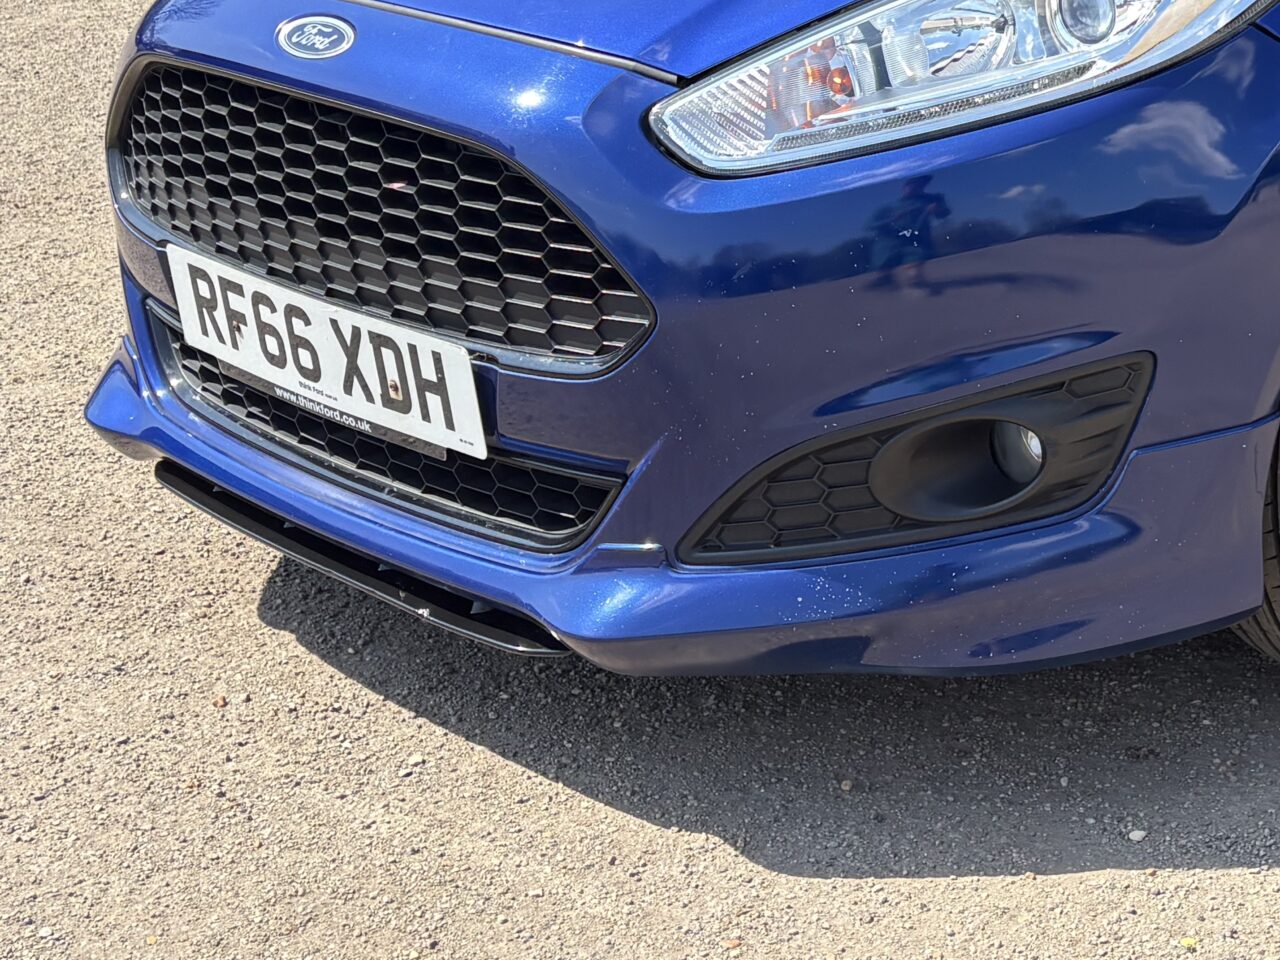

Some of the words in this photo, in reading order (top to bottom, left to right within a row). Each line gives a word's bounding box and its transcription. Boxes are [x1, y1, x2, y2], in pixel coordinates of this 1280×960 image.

[291, 23, 338, 50] Ford
[187, 262, 322, 384] RF66
[329, 316, 456, 433] XDH
[274, 386, 372, 433] www.thinkford.co.uk
